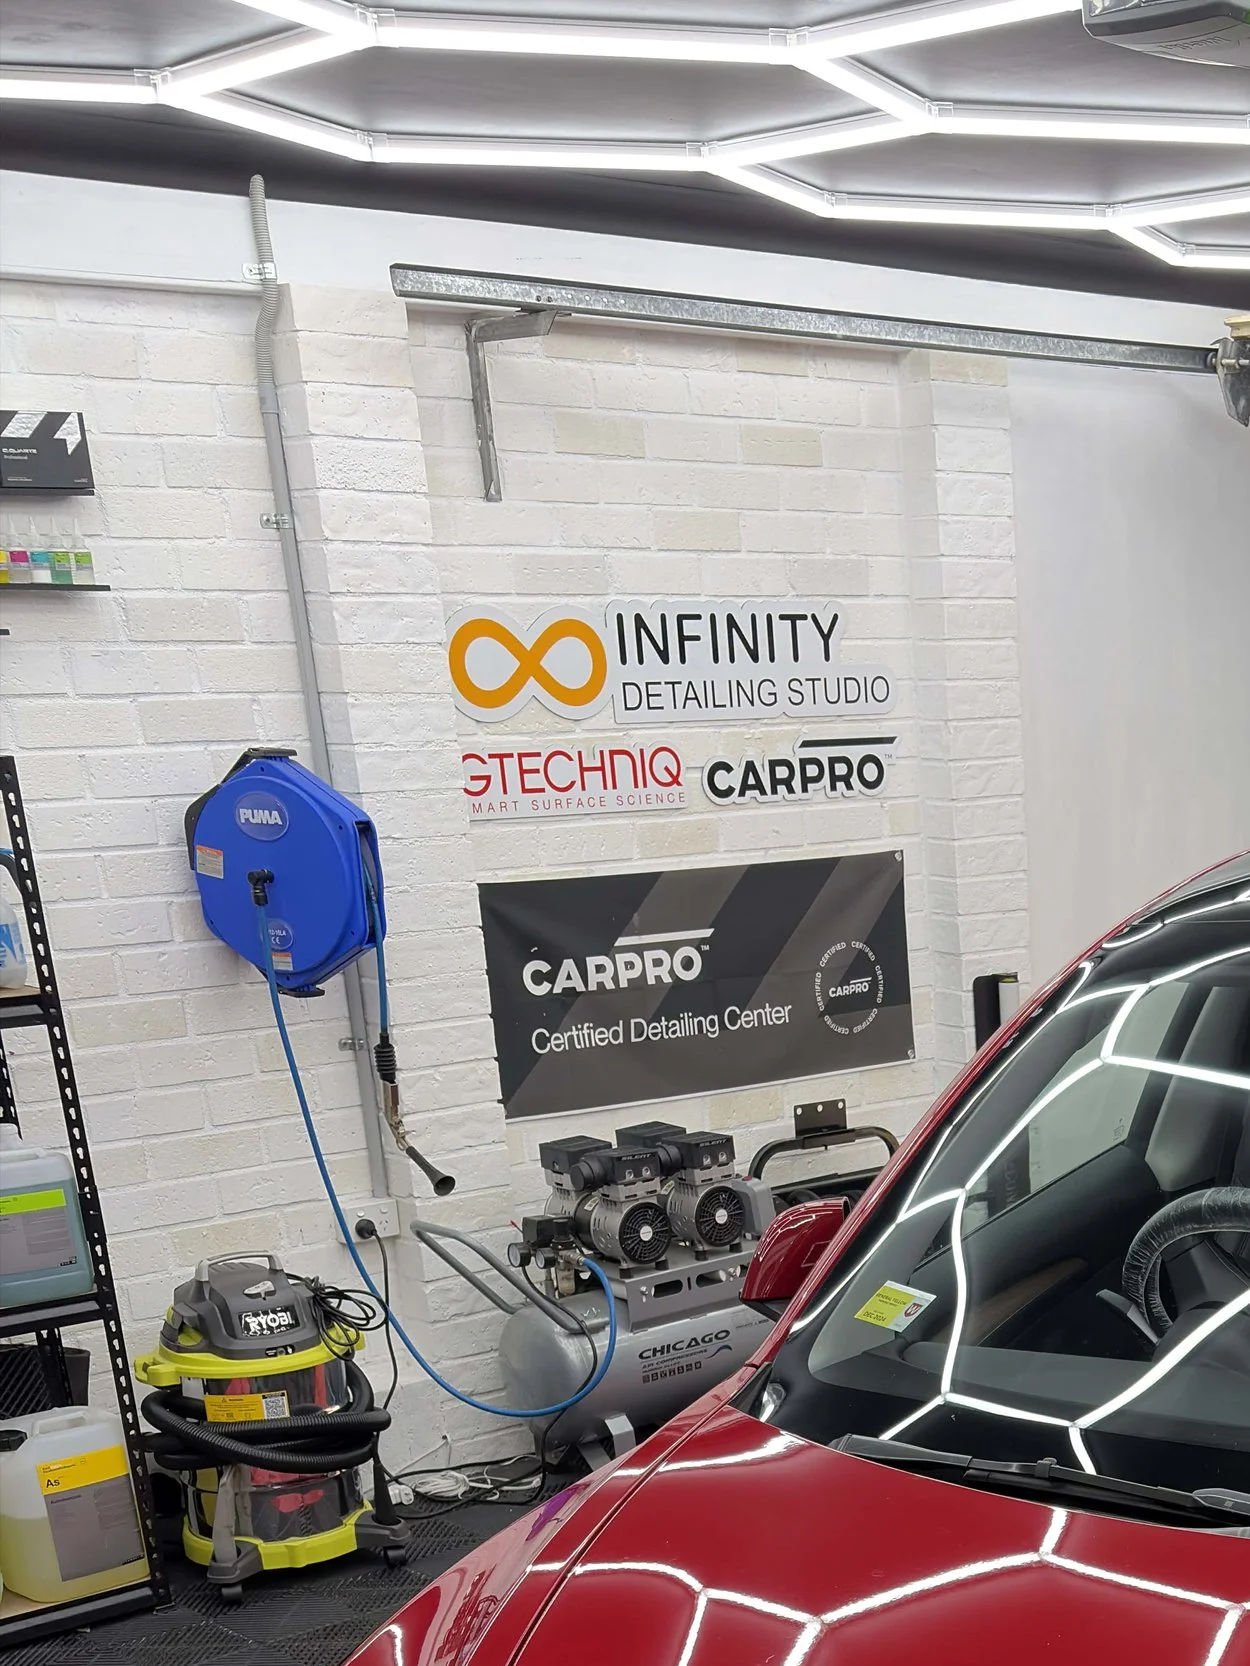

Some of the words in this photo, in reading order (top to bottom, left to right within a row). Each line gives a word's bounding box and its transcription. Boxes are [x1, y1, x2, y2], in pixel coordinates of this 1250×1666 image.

[616, 612, 839, 666] INFINITY
[622, 679, 777, 711] DETAILING
[788, 675, 891, 706] STUDIO
[462, 746, 684, 797] GTECHNIQ
[706, 753, 885, 799] CARPRO
[472, 800, 519, 814] MART
[531, 797, 606, 811] SURFACE
[616, 791, 686, 807] SCIENCE
[239, 808, 283, 825] PUMA
[819, 942, 847, 967] CERTIFIED
[851, 941, 876, 962] CERTIFIED
[522, 945, 703, 997] CARPRO
[814, 972, 825, 1011] CERTIFIED
[829, 981, 870, 998] CARPRO
[875, 965, 884, 1004] CERTIFIED
[531, 1020, 624, 1055] Certified
[630, 1012, 720, 1043] Detailing
[724, 1003, 792, 1031] Center
[823, 1015, 850, 1035] CERTIFIED
[853, 1008, 878, 1034] CERTIFIED
[700, 1139, 728, 1147] SILENT
[621, 1153, 652, 1161] SILENT
[244, 1311, 293, 1333] RYOBI
[638, 1329, 731, 1360] CHICAGO
[46, 1479, 60, 1489] As
